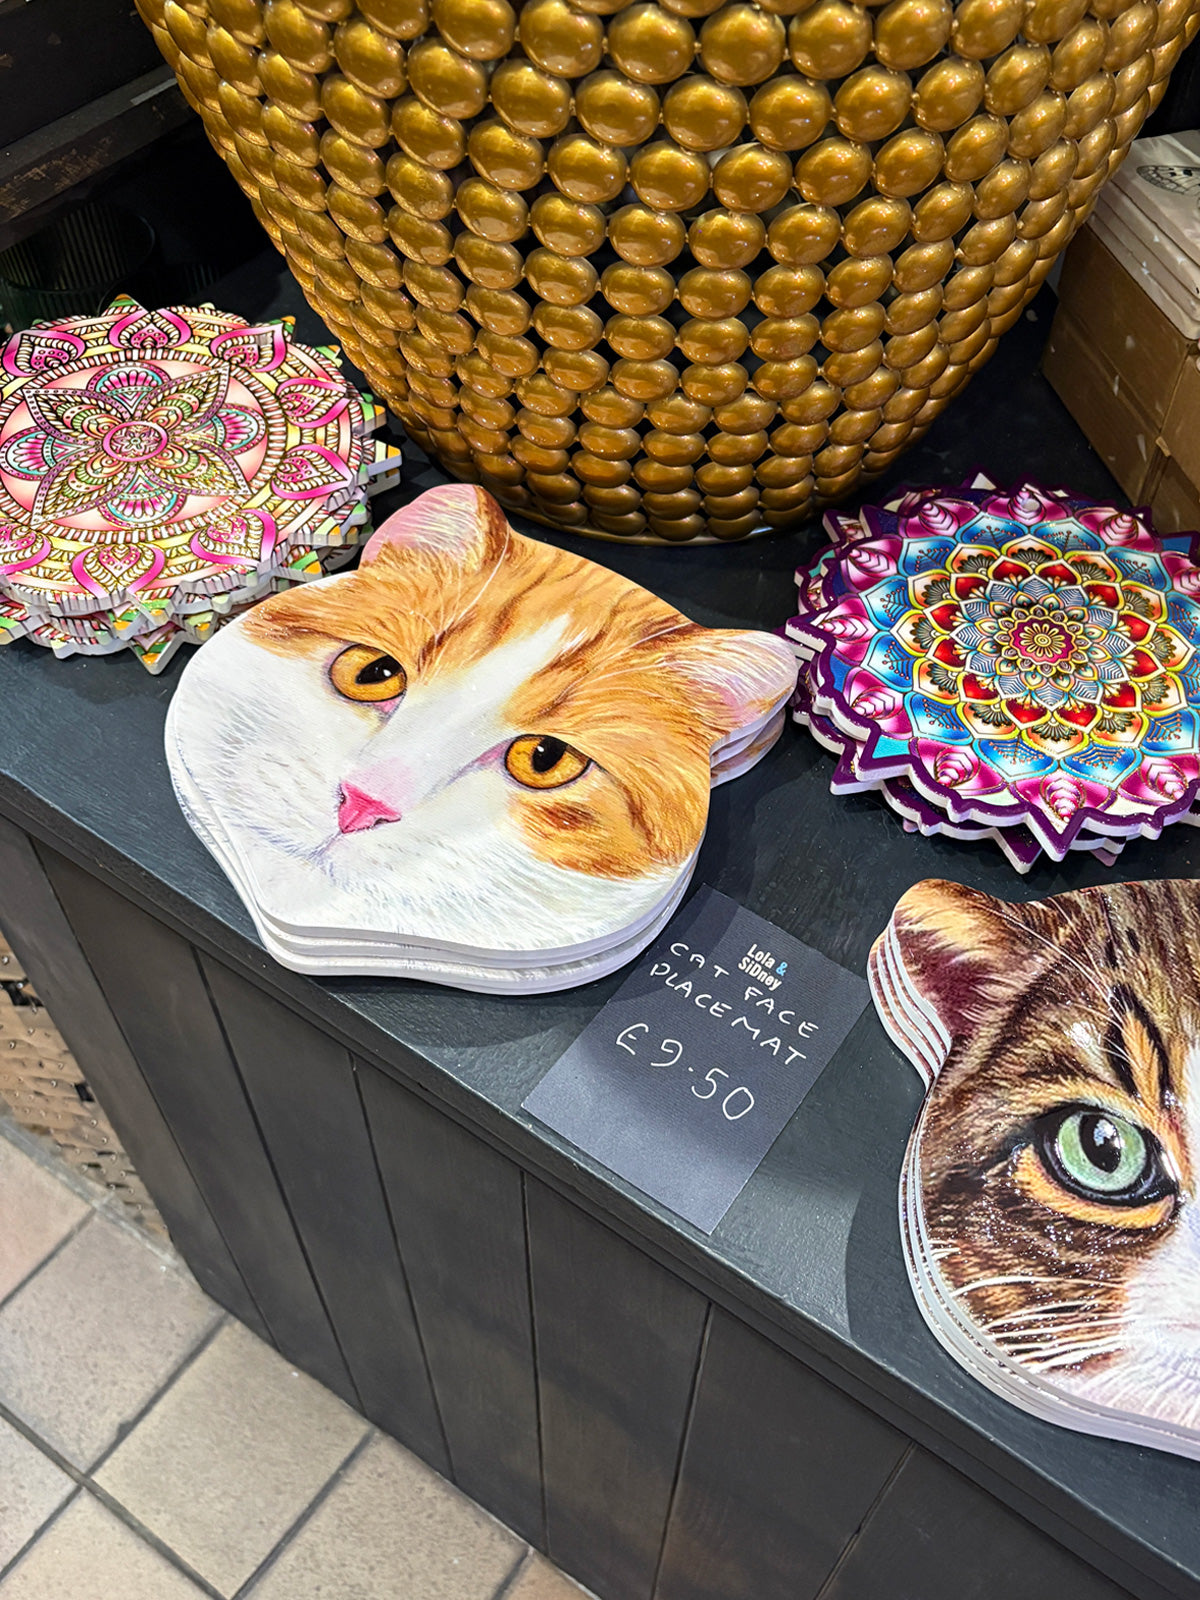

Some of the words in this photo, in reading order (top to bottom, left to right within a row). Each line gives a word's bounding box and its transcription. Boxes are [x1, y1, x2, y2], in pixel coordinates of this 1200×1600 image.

[669, 942, 730, 979] CAT
[743, 986, 819, 1039] FACE
[746, 943, 777, 968] Lola
[776, 961, 788, 976] &
[616, 1022, 755, 1121] £9.50
